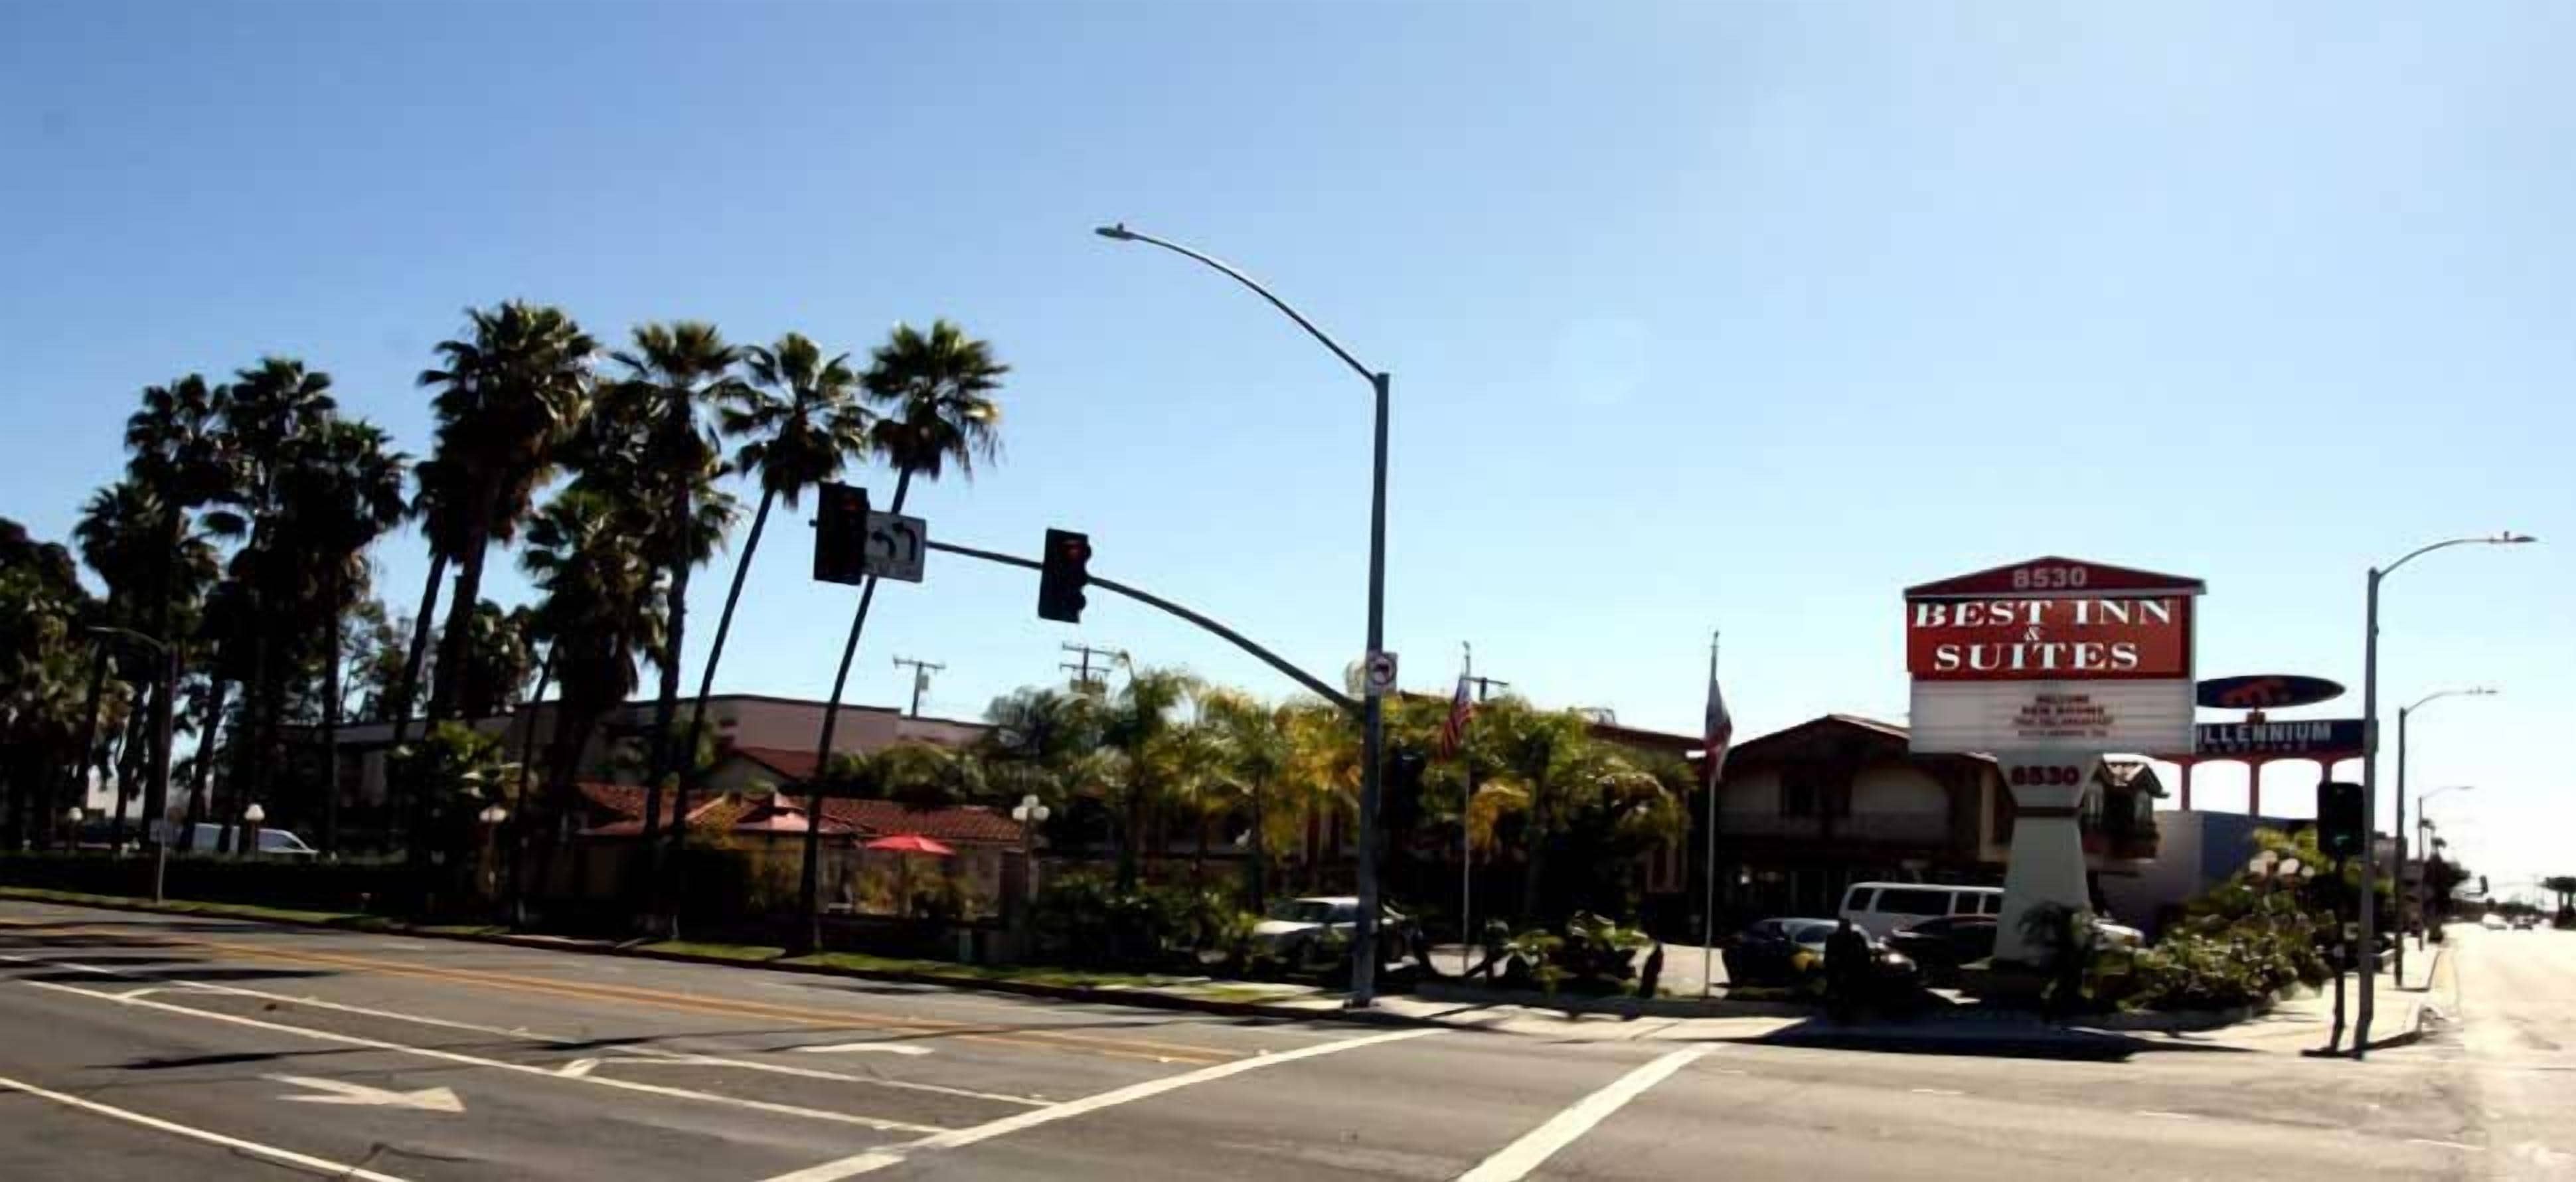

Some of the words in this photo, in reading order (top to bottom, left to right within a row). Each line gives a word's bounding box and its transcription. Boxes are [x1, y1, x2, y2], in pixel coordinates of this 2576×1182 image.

[2013, 566, 2087, 588] 8530
[1913, 600, 2052, 628] BEST
[2071, 600, 2171, 626] INN
[2024, 626, 2041, 641] &
[1934, 642, 2138, 671] SUITES
[2196, 722, 2331, 744] ILLENNIUM
[2011, 765, 2079, 786] 8530
